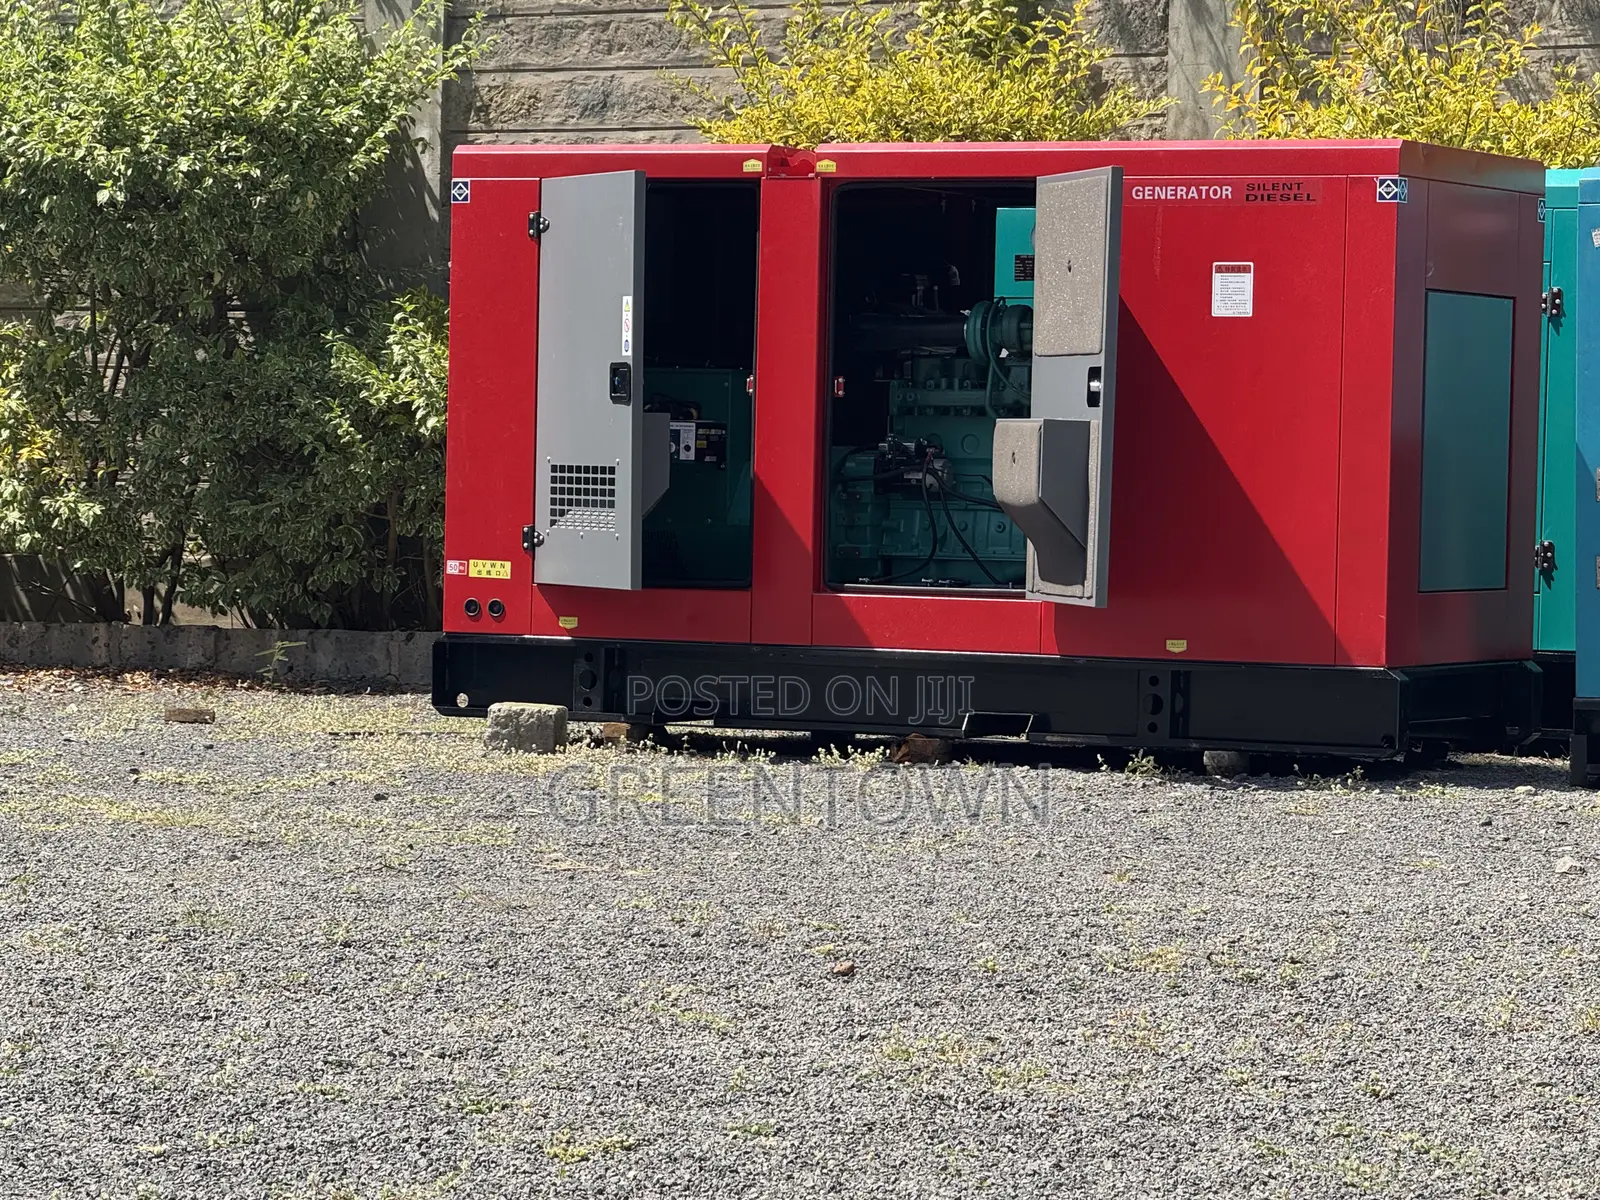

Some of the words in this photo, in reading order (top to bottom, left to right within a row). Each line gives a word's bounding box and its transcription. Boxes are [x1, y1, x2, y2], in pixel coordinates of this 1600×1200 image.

[1245, 182, 1304, 191] SILENT
[1131, 185, 1232, 200] GENERATOR
[1245, 193, 1317, 202] DIESEL
[449, 563, 458, 571] 50
